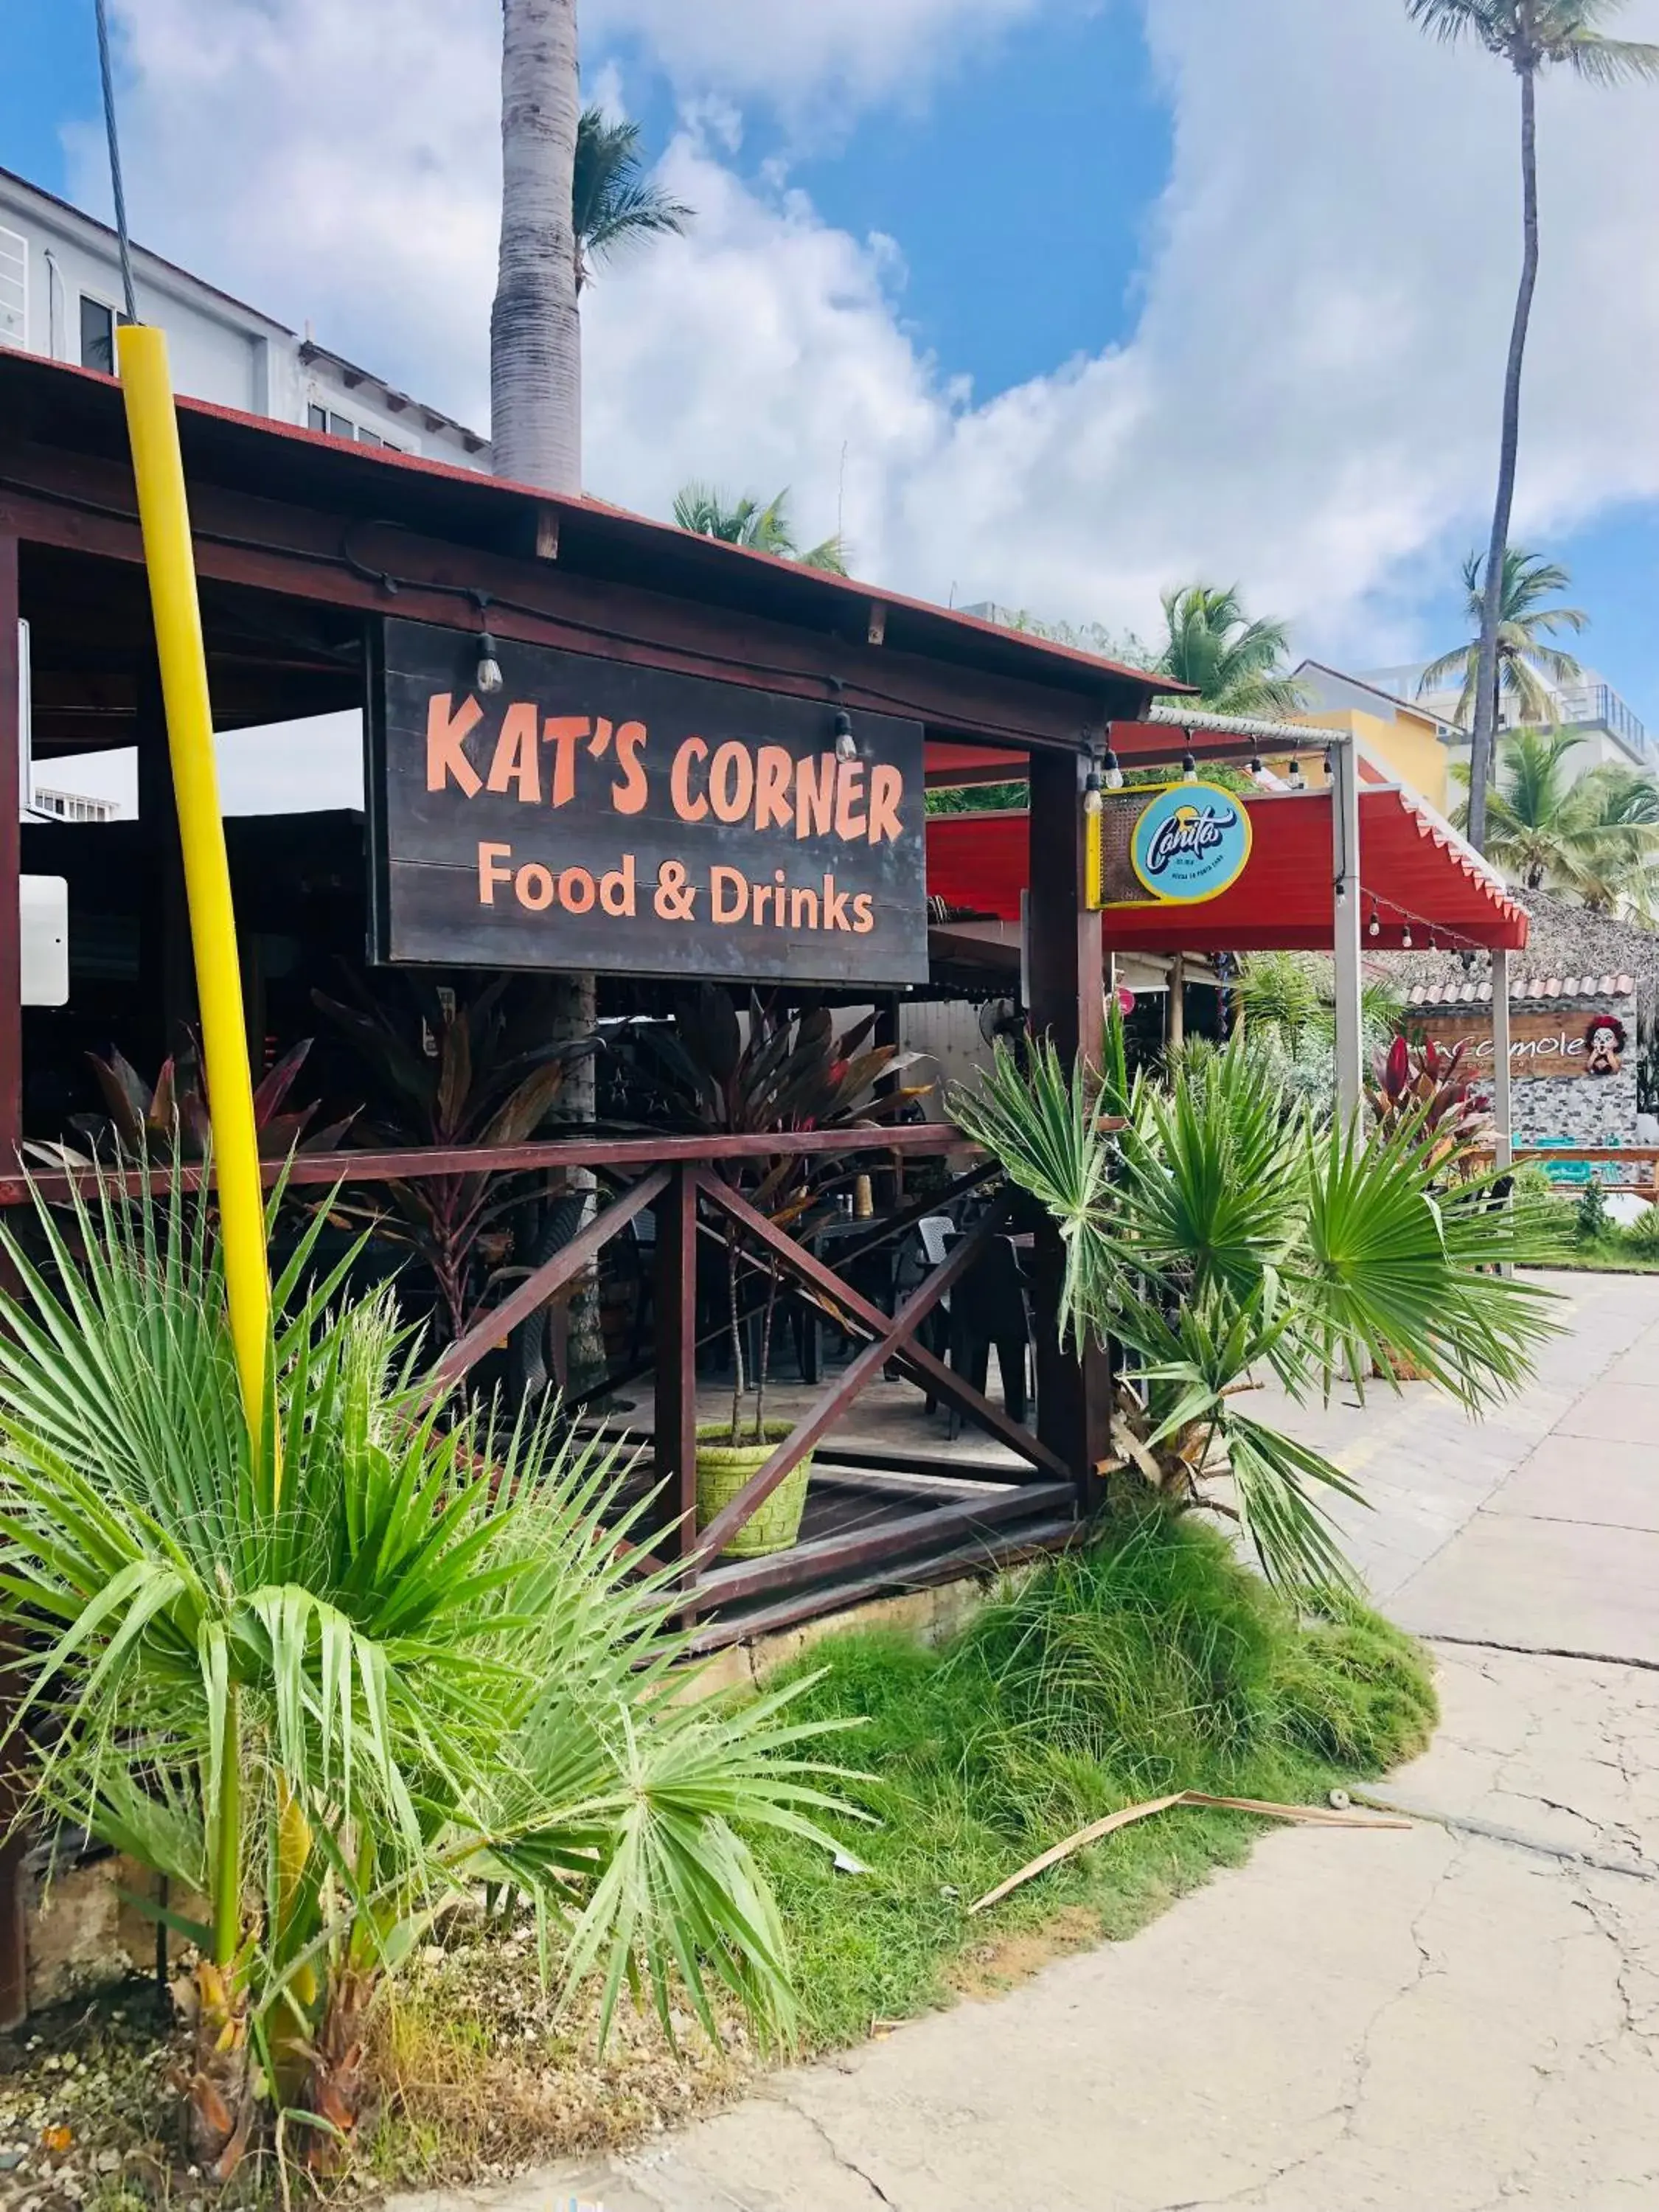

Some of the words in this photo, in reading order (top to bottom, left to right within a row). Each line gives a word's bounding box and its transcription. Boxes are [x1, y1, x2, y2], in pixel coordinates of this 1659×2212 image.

[425, 692, 648, 815] KAT'S
[670, 736, 904, 846] CORNER
[478, 841, 636, 917] Food
[654, 860, 695, 921] &
[710, 866, 875, 933] Drinks
